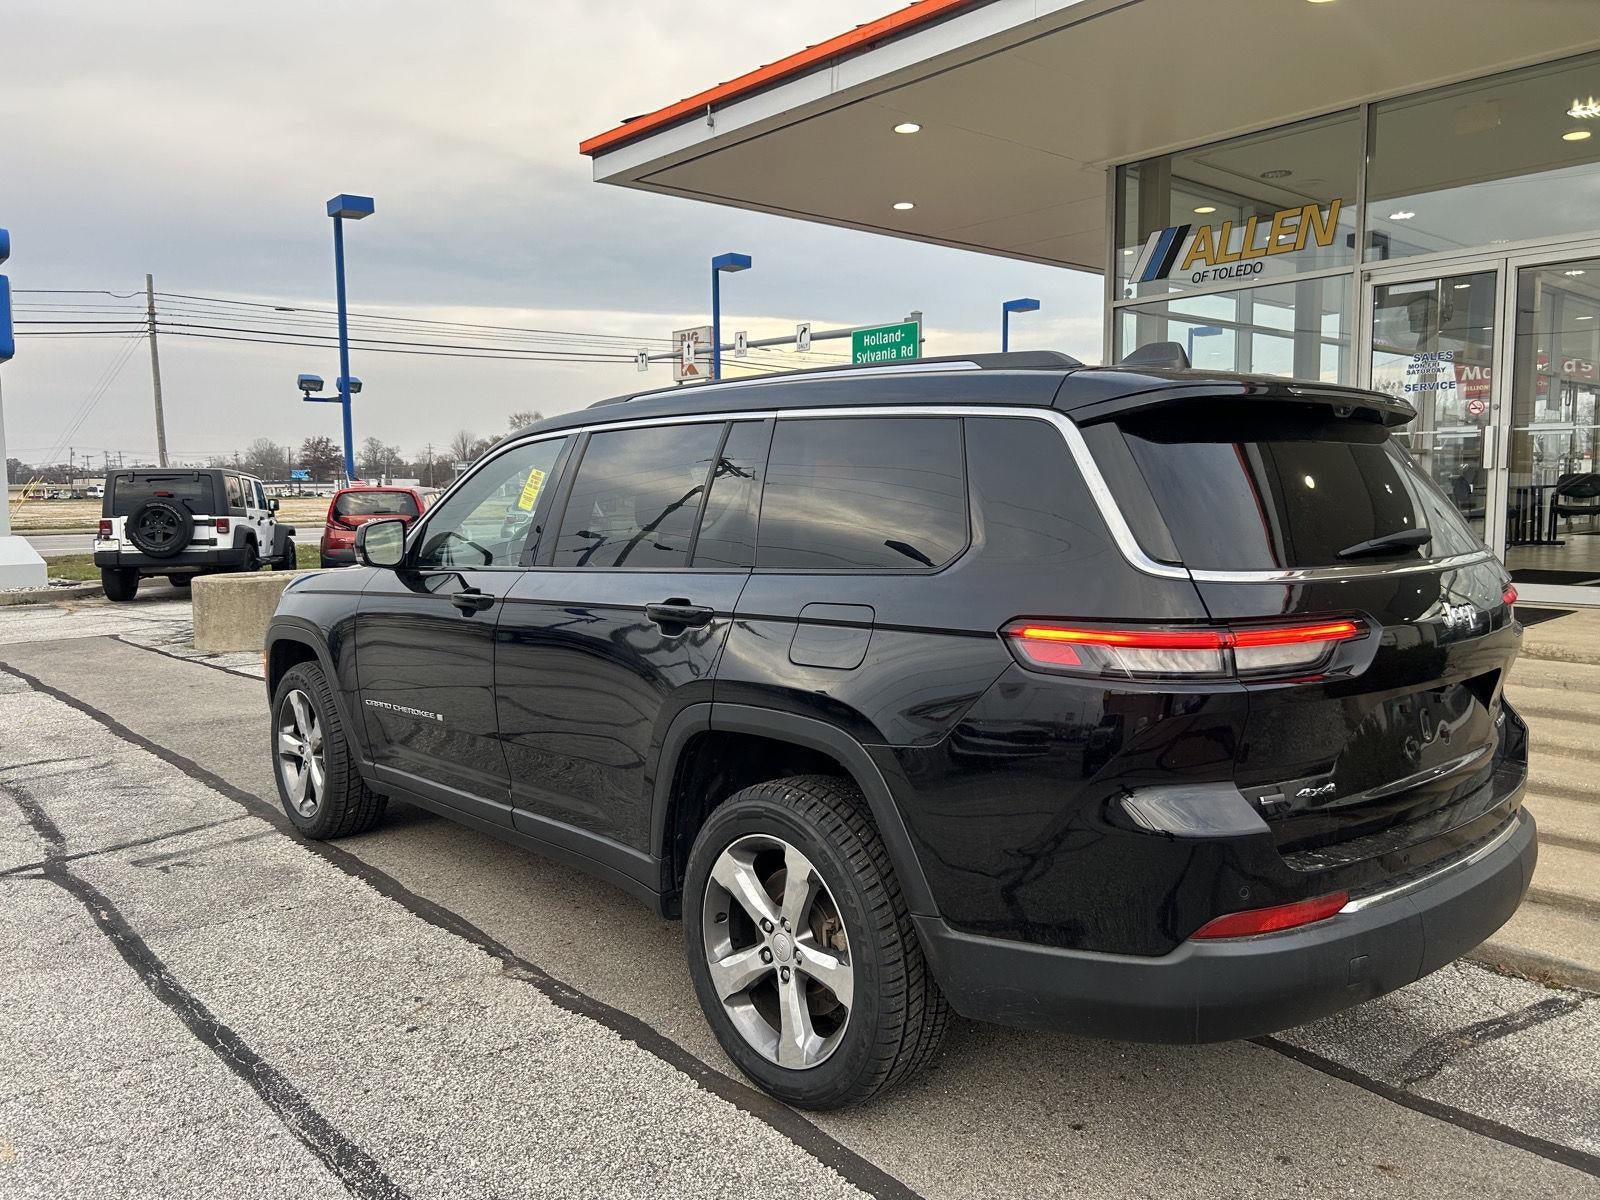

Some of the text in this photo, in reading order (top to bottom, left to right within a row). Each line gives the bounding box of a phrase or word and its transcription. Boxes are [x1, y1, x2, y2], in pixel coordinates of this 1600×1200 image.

[1180, 198, 1342, 270] ALLEN
[1192, 261, 1263, 284] OF TOLEDO
[863, 329, 905, 346] Holland-
[856, 343, 913, 364] Sylvania Rd
[1413, 350, 1454, 362] SALES
[1406, 366, 1447, 376] SATURDAY
[1404, 381, 1457, 393] SERVICE
[365, 699, 392, 710] GRAND
[393, 704, 436, 720] CHEROKEE
